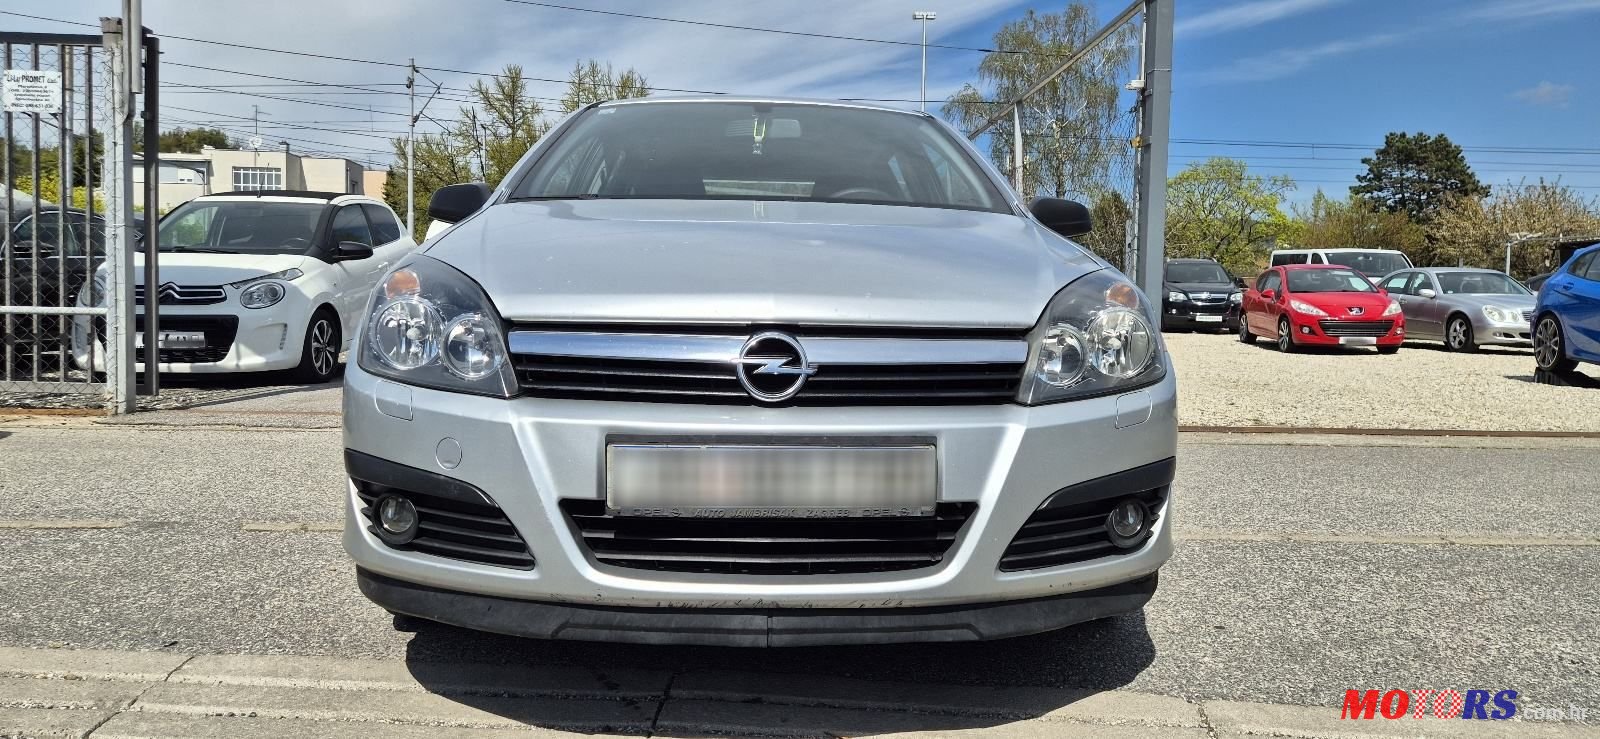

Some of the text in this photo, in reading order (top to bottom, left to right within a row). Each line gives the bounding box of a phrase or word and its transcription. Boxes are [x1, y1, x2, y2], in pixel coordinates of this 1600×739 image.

[22, 75, 45, 83] PROMET
[633, 508, 668, 517] OPEL
[694, 508, 725, 517] AUTO
[806, 507, 850, 517] ZAGREB
[862, 507, 897, 517] OPEL
